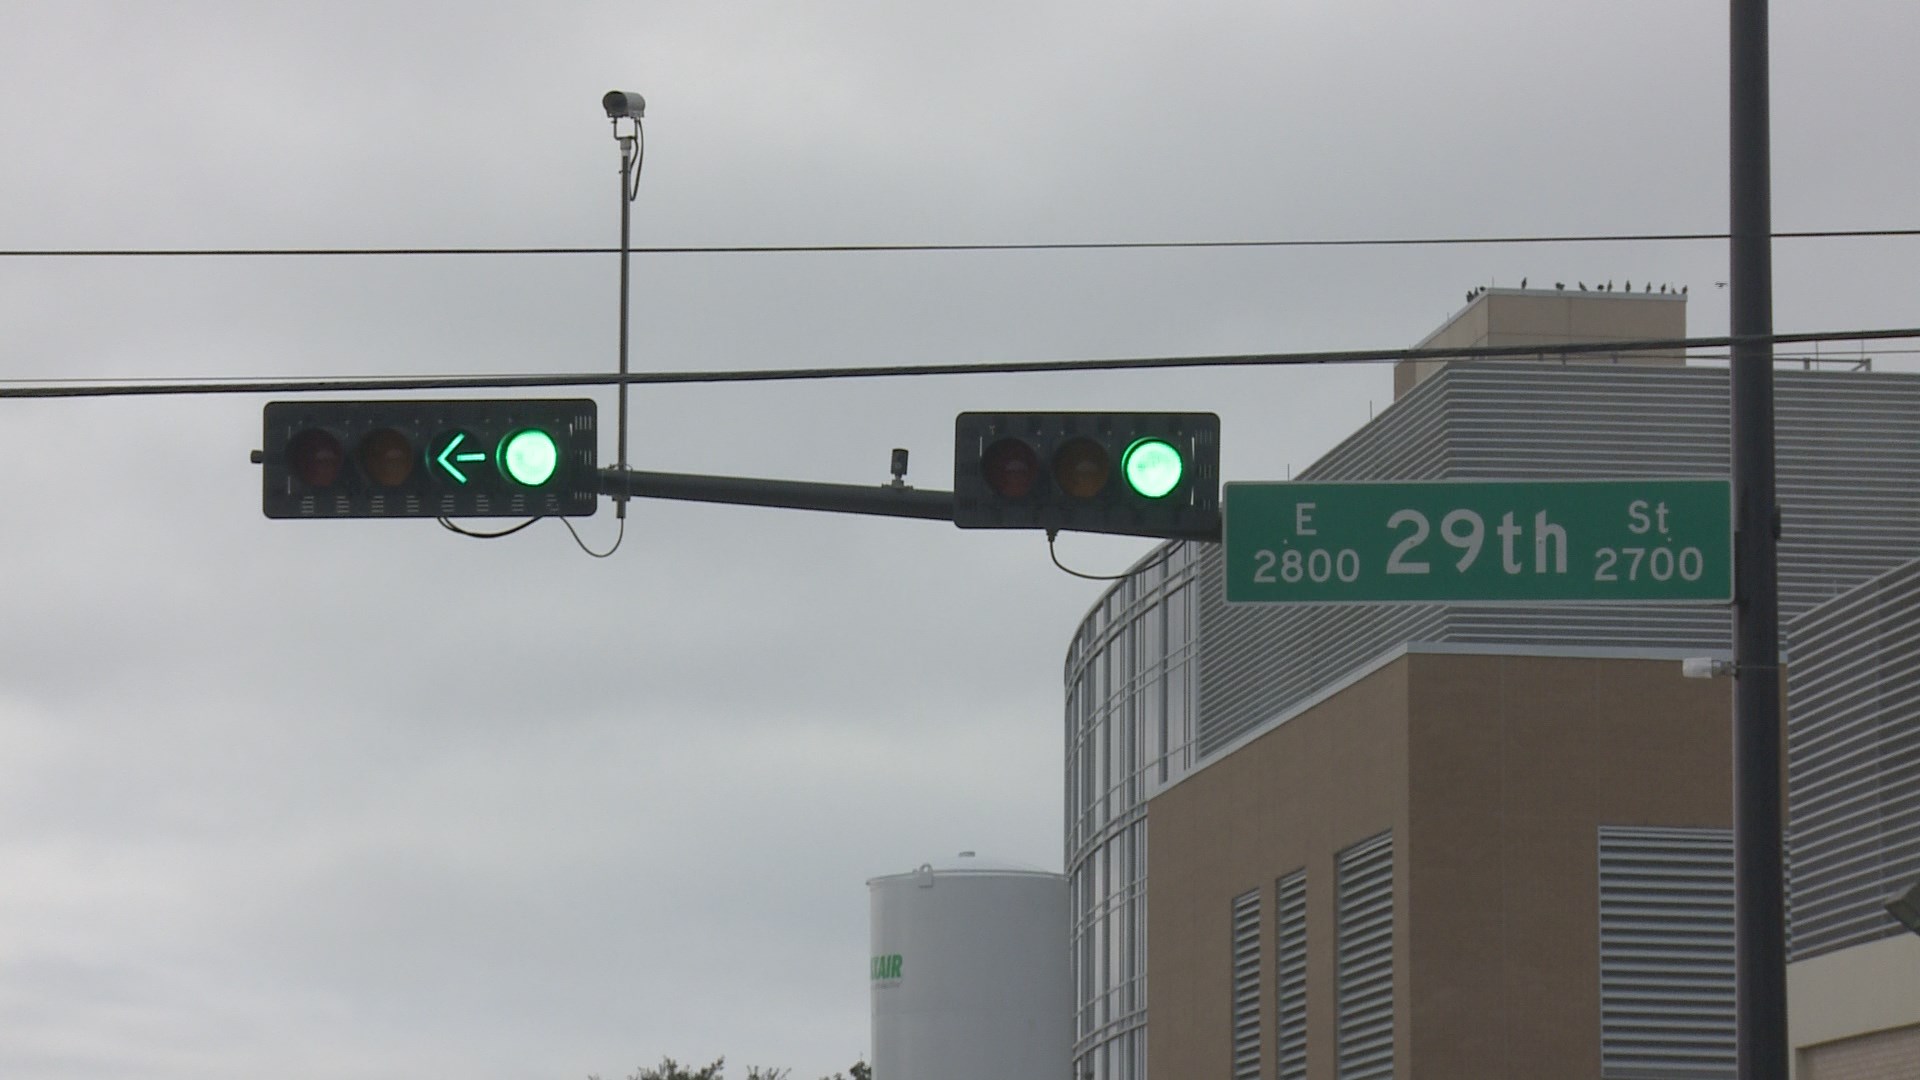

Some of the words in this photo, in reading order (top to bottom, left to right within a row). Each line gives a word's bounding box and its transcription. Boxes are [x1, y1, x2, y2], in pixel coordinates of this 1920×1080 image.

[1295, 502, 1317, 535] E
[1386, 508, 1568, 574] 29th
[1628, 500, 1669, 534] St
[1253, 549, 1360, 583] 2800
[1594, 547, 1704, 581] 2700
